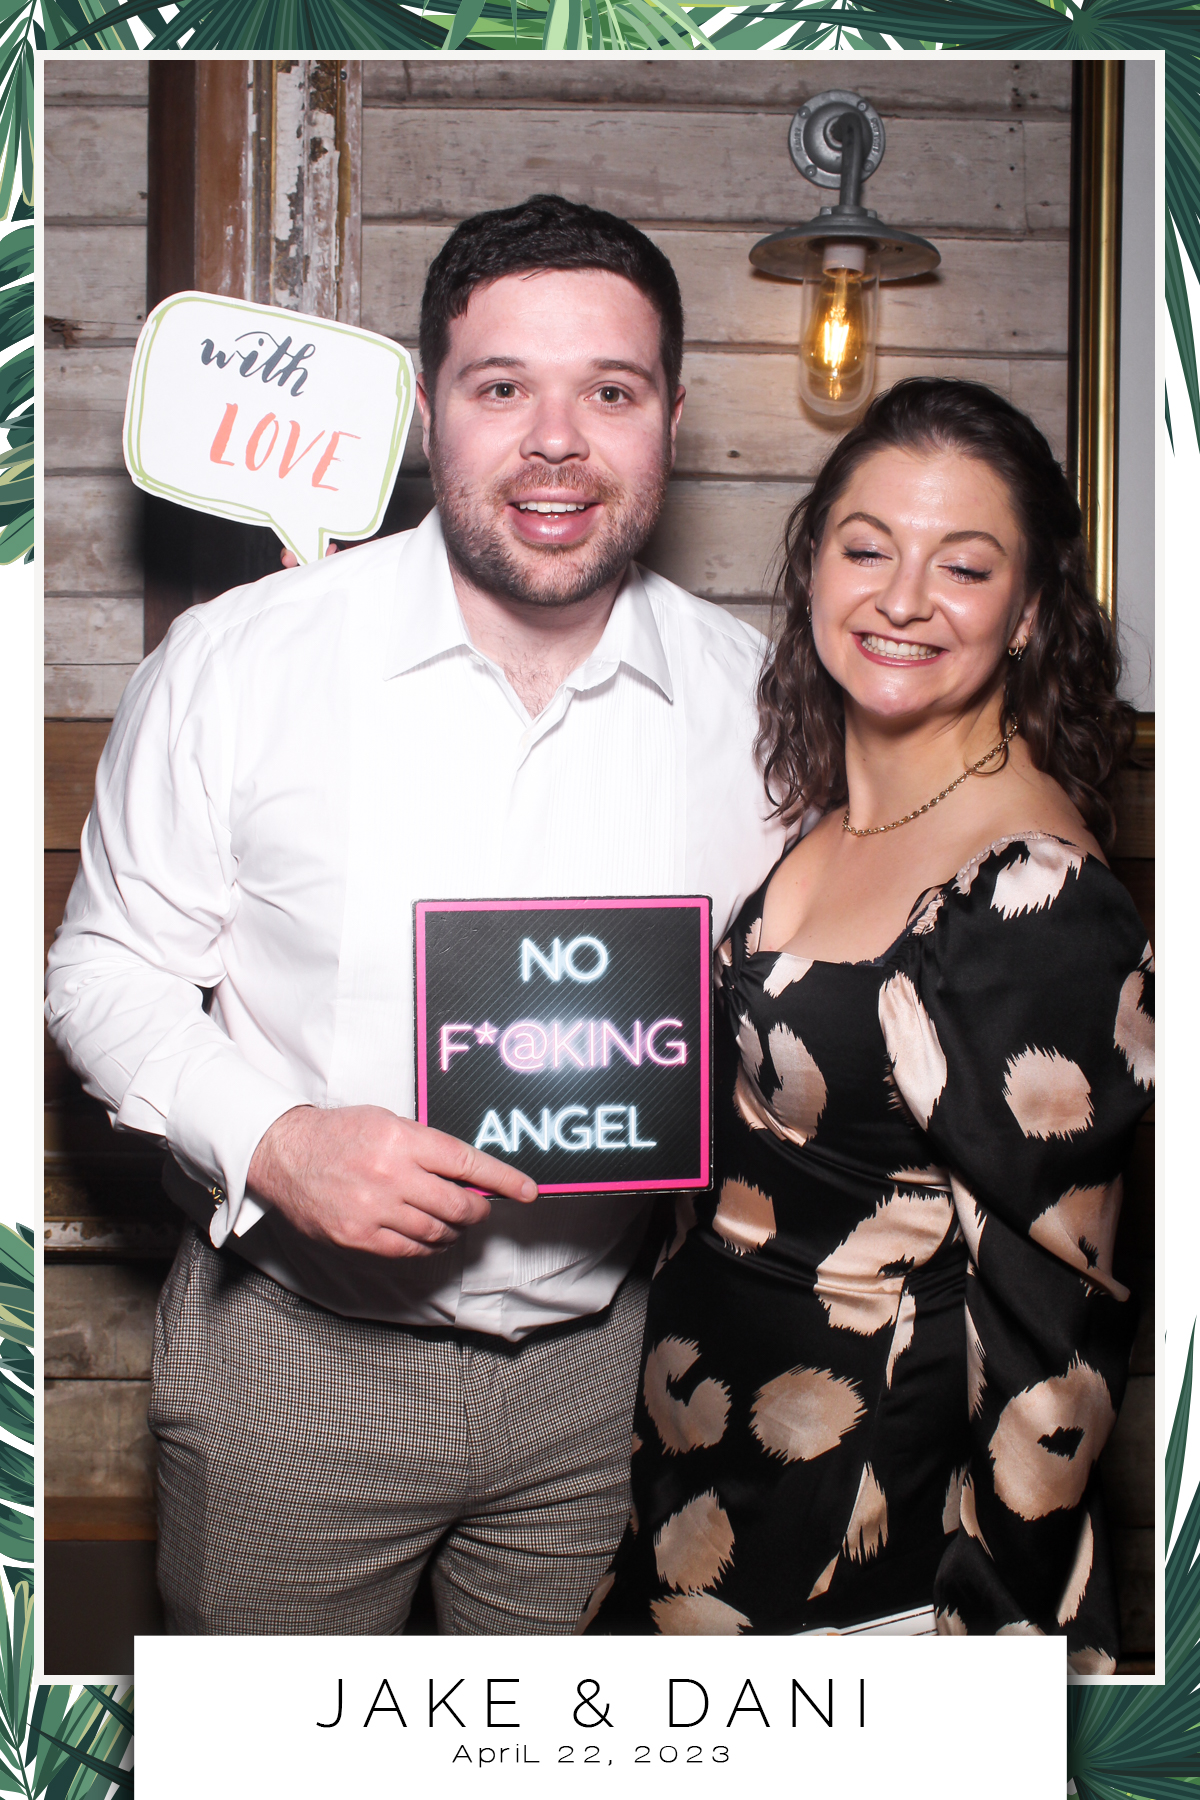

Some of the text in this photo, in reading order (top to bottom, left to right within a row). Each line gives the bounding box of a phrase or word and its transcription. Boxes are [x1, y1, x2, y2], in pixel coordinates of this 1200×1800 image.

[200, 331, 316, 397] with
[209, 402, 362, 492] LOVE
[521, 936, 609, 982] NO
[474, 1105, 657, 1152] ANGEL
